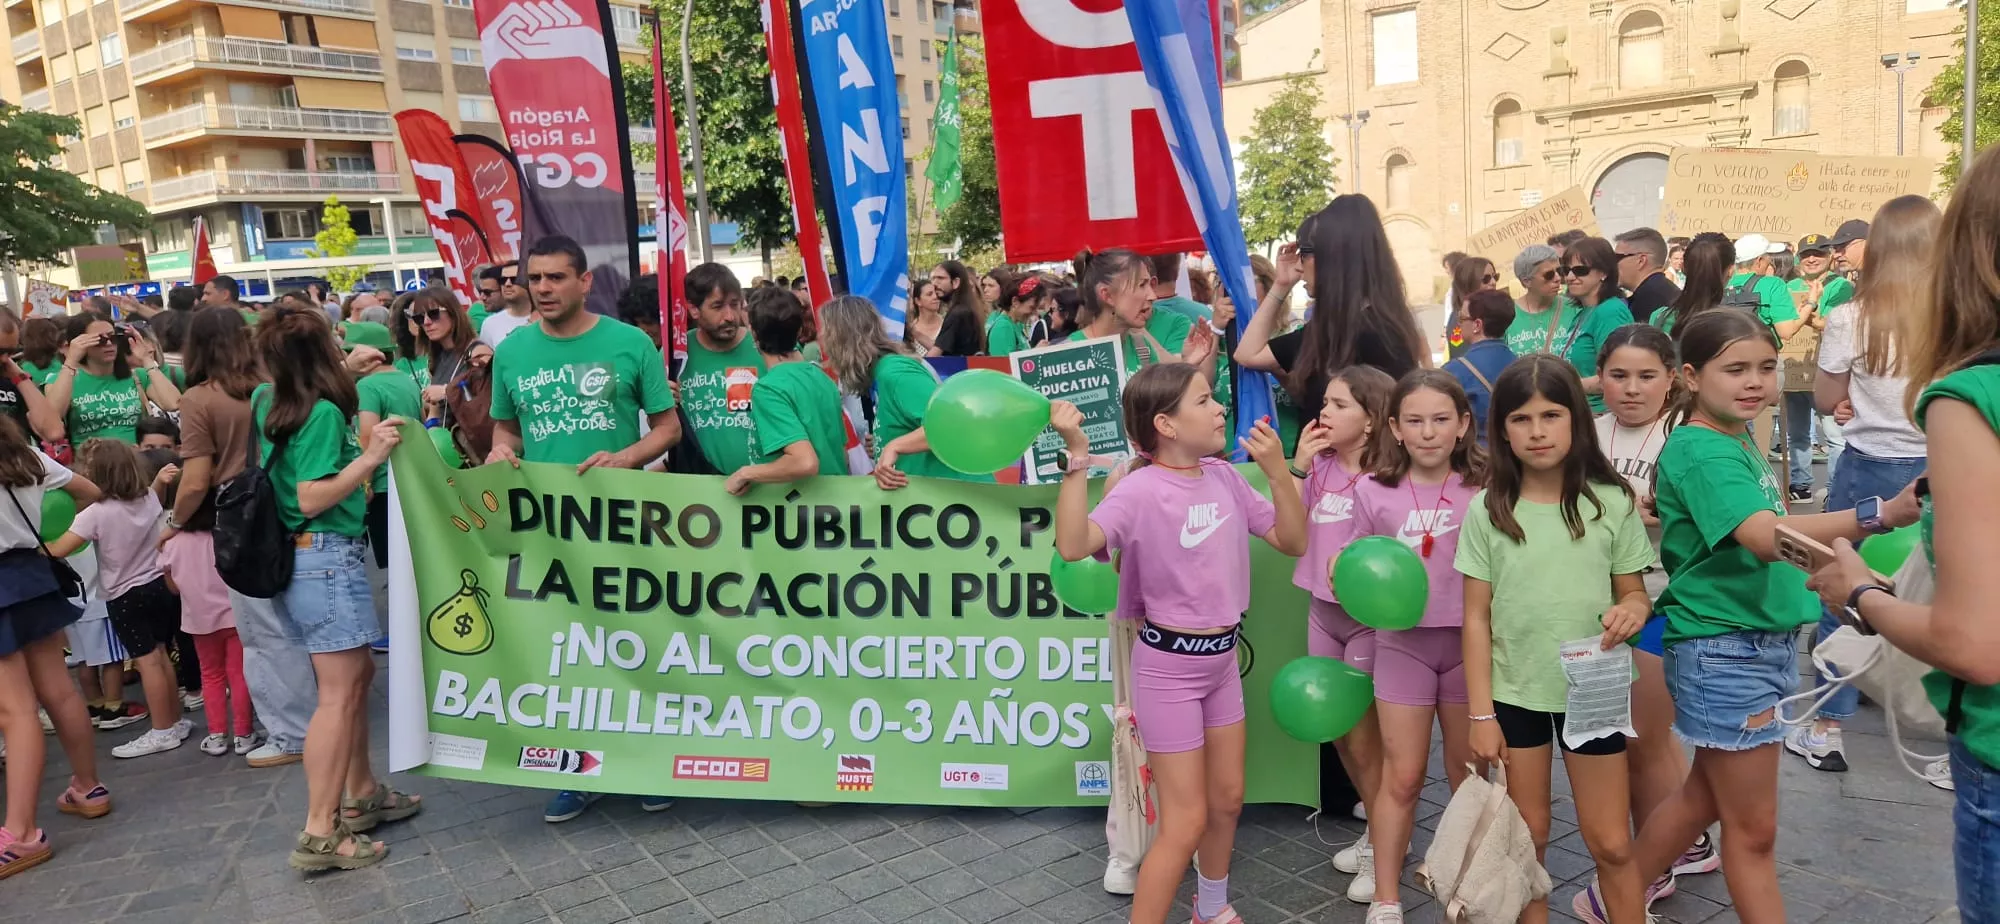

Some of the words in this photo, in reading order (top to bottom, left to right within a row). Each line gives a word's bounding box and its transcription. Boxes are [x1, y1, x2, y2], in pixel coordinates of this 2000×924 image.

[1713, 161, 1769, 181] verano
[1042, 358, 1096, 378] HUELGA
[517, 367, 567, 392] ESCUELA
[532, 400, 552, 416] DE
[507, 487, 722, 548] DINERO
[741, 488, 1001, 557] PÚBLICO,
[1187, 502, 1222, 529] NIKE
[1405, 509, 1454, 532] NIKE
[504, 553, 579, 606] LA
[592, 556, 931, 618] EDUCACIÓN
[549, 622, 648, 678] ¡NO
[656, 631, 725, 675] AL
[735, 634, 1027, 682] CONCIERTO
[1172, 634, 1233, 652] NIKE
[432, 668, 836, 750] BACHILLERATO,
[849, 696, 934, 744] 0-3
[942, 687, 1092, 749] AÑOS
[526, 747, 558, 759] CGT
[677, 759, 740, 777] CCOO
[837, 772, 874, 784] HUSTE
[944, 771, 969, 782] UGT
[1079, 779, 1109, 789] ANPE
